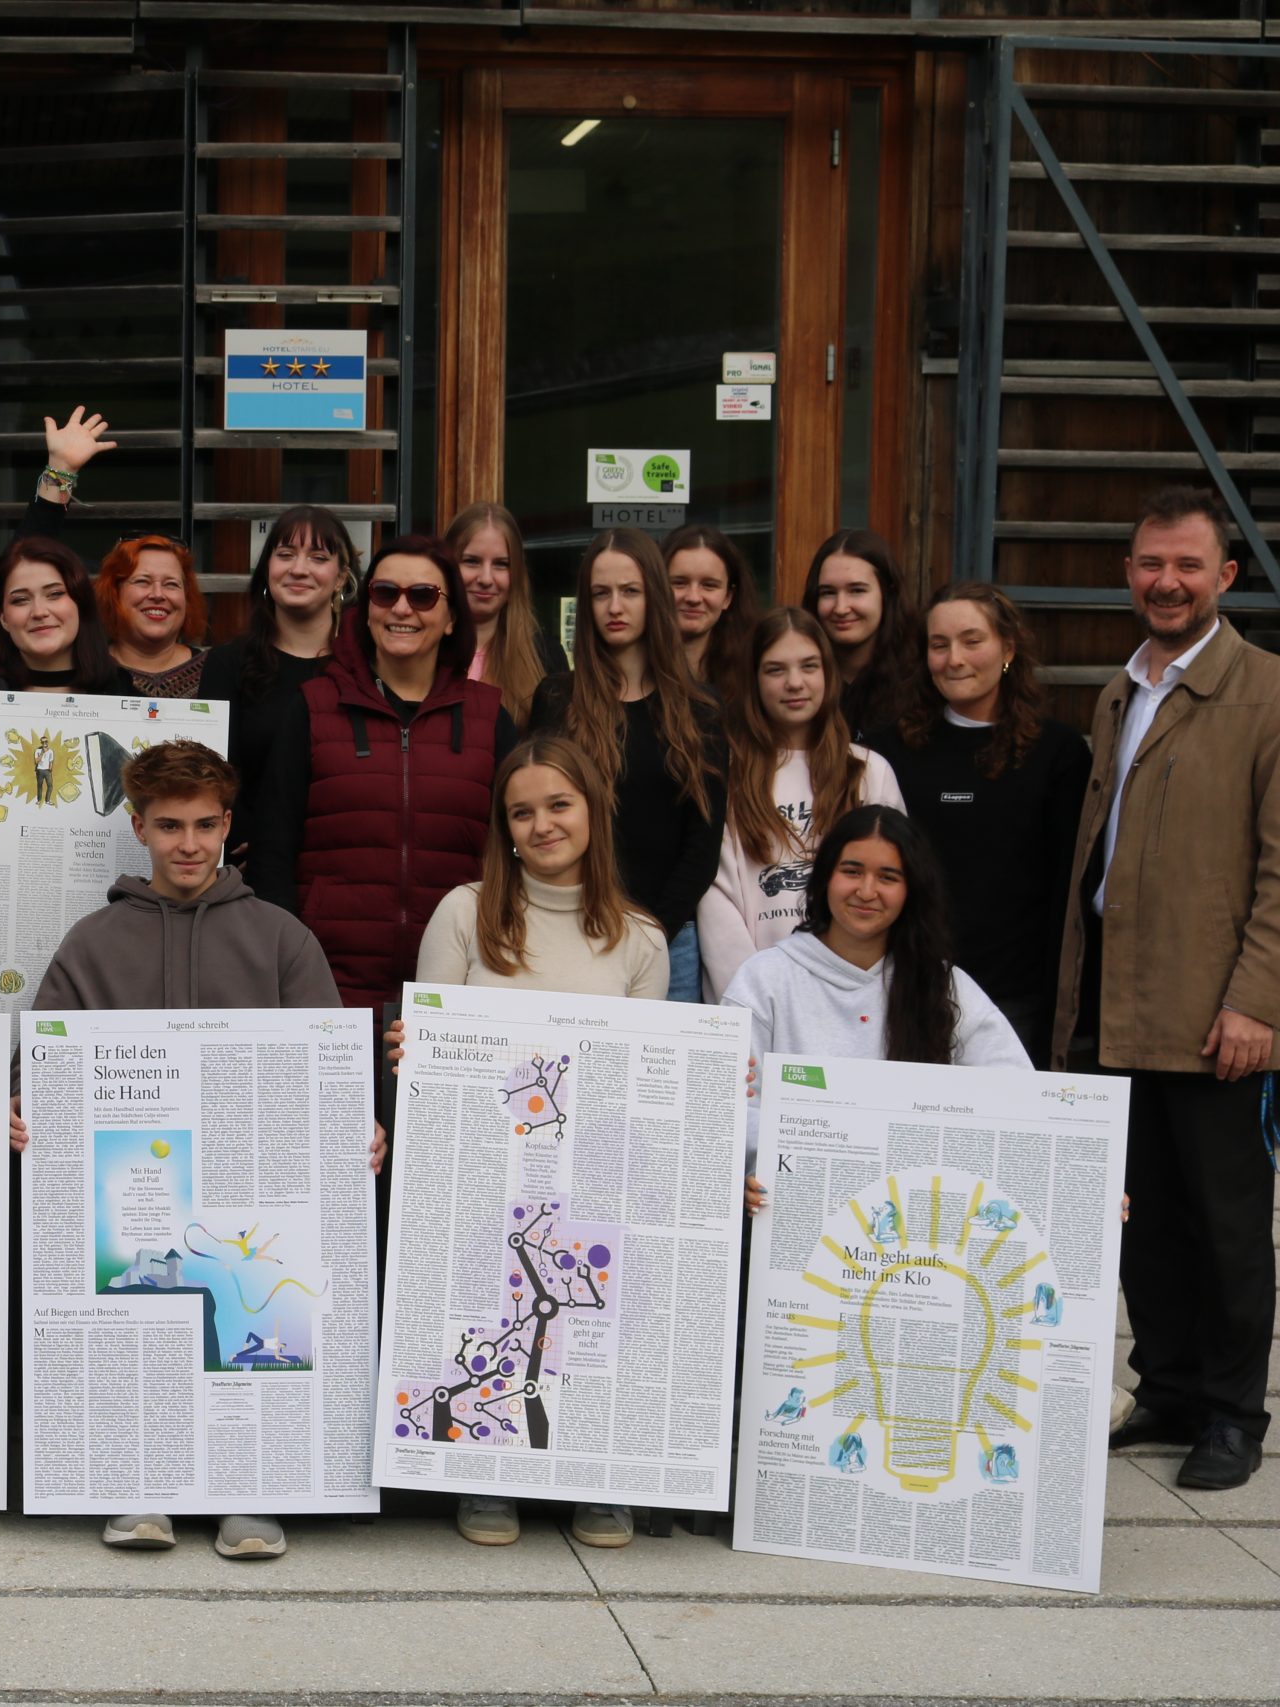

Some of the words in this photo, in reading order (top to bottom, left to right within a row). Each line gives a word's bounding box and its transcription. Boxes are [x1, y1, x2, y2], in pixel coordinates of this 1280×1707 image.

[272, 382, 318, 390] HOTEL
[651, 462, 669, 470] Safe
[602, 510, 666, 522] HOTEL
[44, 708, 69, 719] Jugend
[72, 710, 99, 718] schreibt
[70, 828, 93, 836] Sehen
[74, 840, 106, 848] gesehen
[75, 851, 103, 859] werden
[167, 1022, 195, 1030] Jugend
[547, 1015, 575, 1025] Jugend
[578, 1018, 608, 1028] schreibt
[419, 1029, 436, 1041] Da
[439, 1031, 478, 1044] staunt
[481, 1036, 508, 1046] man
[95, 1045, 111, 1060] Er
[116, 1044, 136, 1060] fiel
[140, 1047, 166, 1060] den
[318, 1042, 330, 1051] Sie
[332, 1042, 351, 1051] liebt
[354, 1042, 363, 1051] die
[643, 1045, 675, 1055] Künstler
[319, 1054, 354, 1063] Disziplin
[432, 1047, 493, 1062] Bauklötze
[641, 1056, 676, 1066] brauchen
[94, 1066, 162, 1080] Slowenen
[166, 1066, 180, 1079] in
[646, 1066, 669, 1076] Kohle
[94, 1086, 115, 1100] die
[120, 1086, 160, 1100] Hand
[912, 1102, 940, 1113] Jugend
[943, 1104, 974, 1114] schreibt
[780, 1114, 831, 1128] Einzigartig,
[779, 1127, 796, 1136] weil
[798, 1128, 848, 1141] andersartig
[844, 1245, 877, 1262] Man
[880, 1250, 911, 1266] geht
[914, 1254, 948, 1270] aufs,
[842, 1266, 876, 1282] nicht
[881, 1268, 900, 1283] ins
[905, 1270, 931, 1286] Klo
[768, 1298, 787, 1308] Man
[789, 1301, 809, 1310] lernt
[34, 1308, 49, 1317] Auf
[51, 1308, 77, 1318] Biegen
[97, 1308, 129, 1317] Brechen
[767, 1311, 779, 1319] nie
[568, 1317, 589, 1326] Oben
[592, 1320, 611, 1328] ohne
[573, 1330, 590, 1338] geht
[578, 1340, 598, 1348] nicht
[760, 1428, 800, 1441] Forschung
[801, 1433, 814, 1441] mit
[758, 1440, 789, 1449] anderen
[791, 1442, 820, 1452] Mitteln
